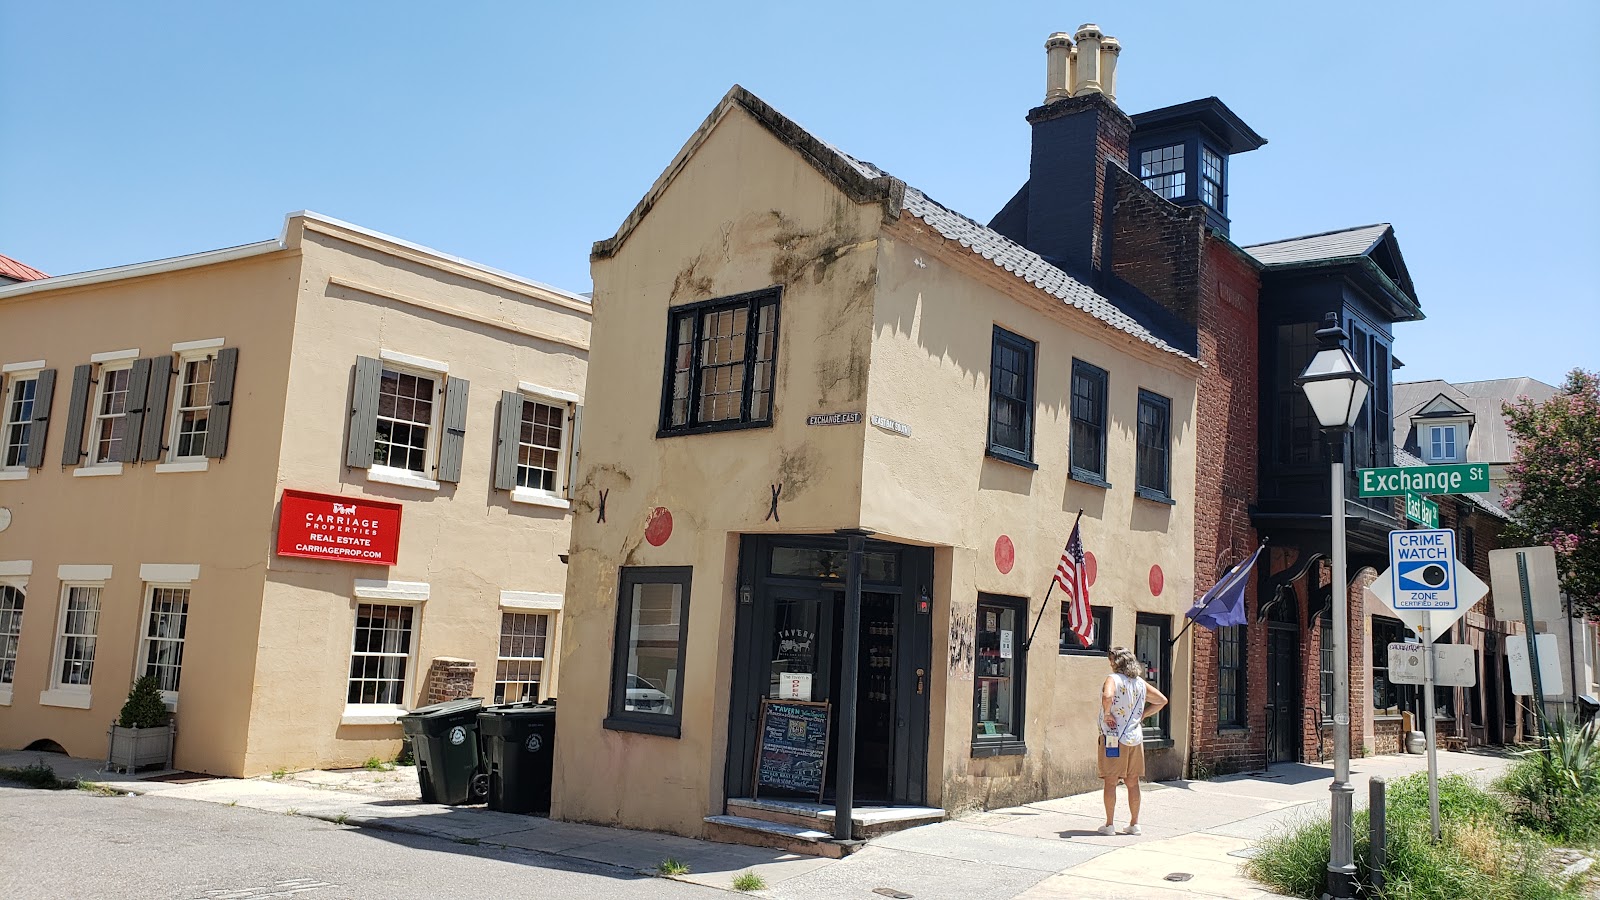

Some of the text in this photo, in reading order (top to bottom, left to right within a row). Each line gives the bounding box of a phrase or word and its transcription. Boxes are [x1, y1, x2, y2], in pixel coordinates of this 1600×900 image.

[1363, 467, 1484, 493] Exchange St
[1407, 493, 1437, 528] East Bay St
[305, 513, 379, 528] CARRIAGE
[305, 522, 377, 536] PROPERTIES
[310, 533, 371, 546] REAL ESTATE
[1399, 534, 1445, 546] CRIME
[295, 544, 382, 558] CARRIAGEPROP.COM
[1398, 548, 1447, 559] WATCH
[1411, 592, 1438, 600] ZONE
[778, 629, 815, 640] TAVERN
[792, 680, 800, 698] OPEN
[772, 705, 800, 714] TAVERN
